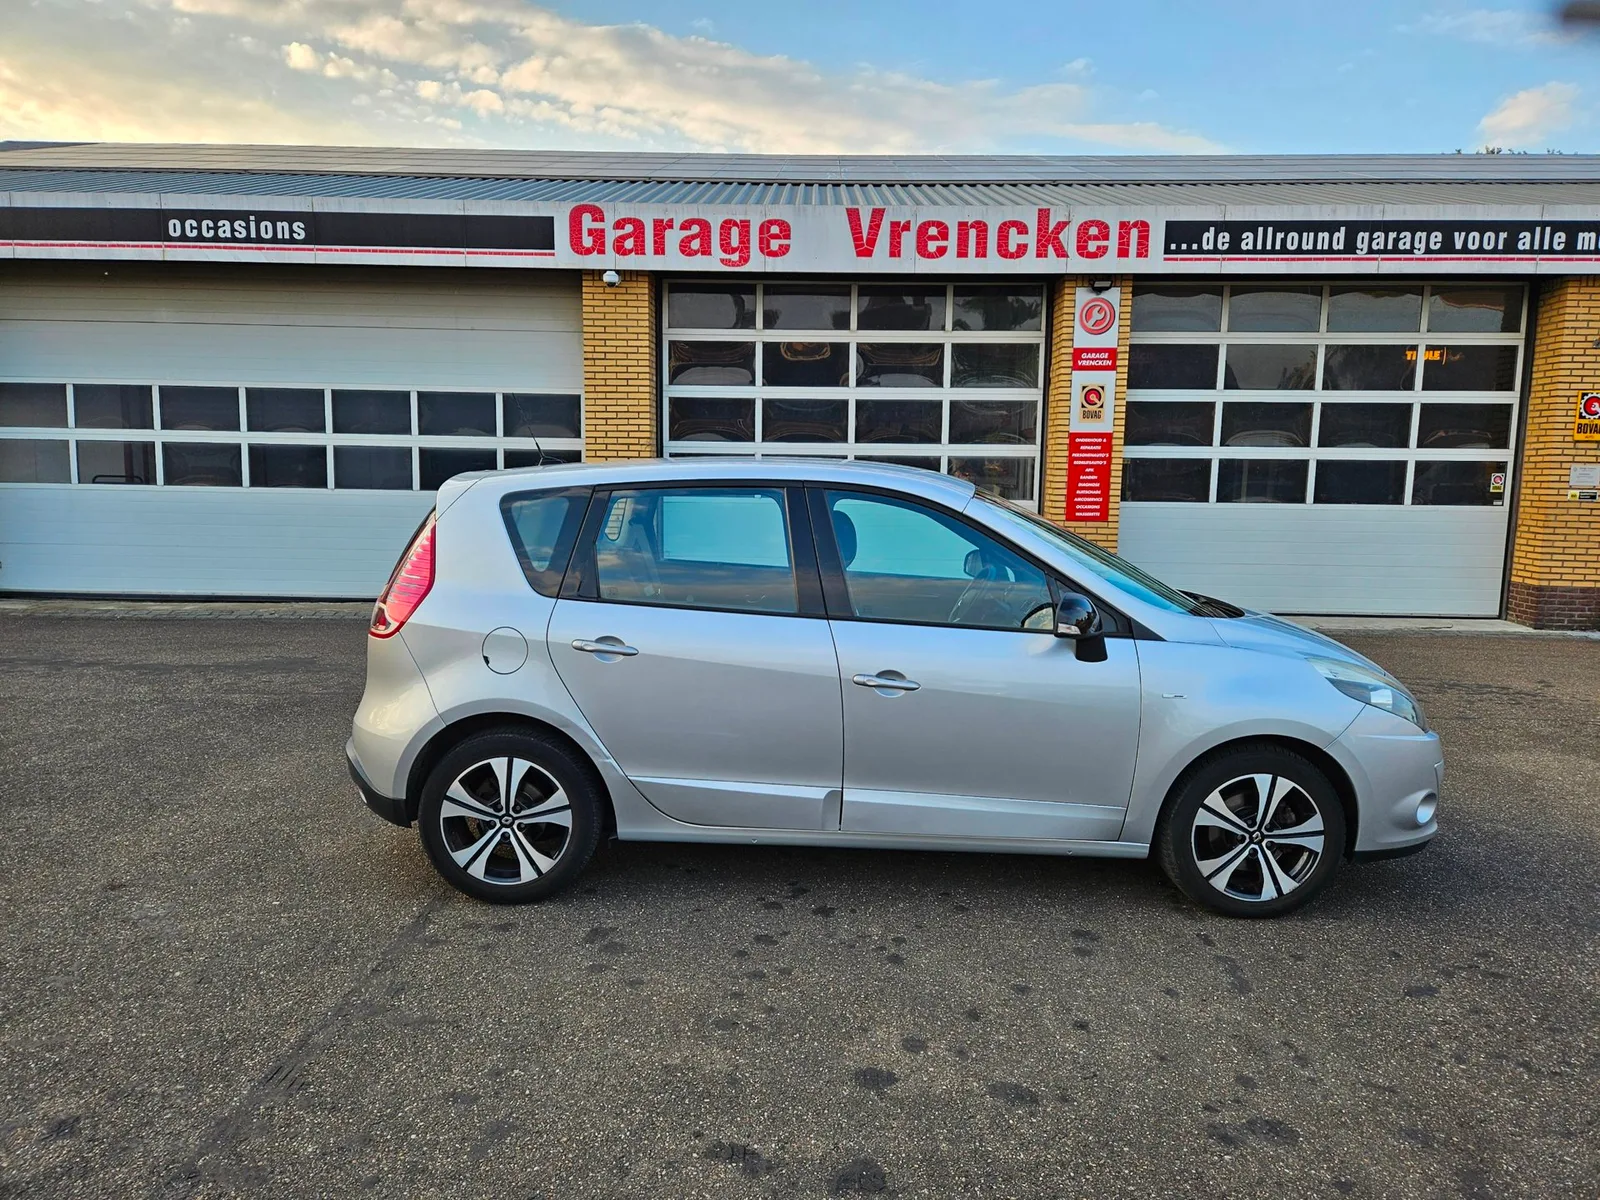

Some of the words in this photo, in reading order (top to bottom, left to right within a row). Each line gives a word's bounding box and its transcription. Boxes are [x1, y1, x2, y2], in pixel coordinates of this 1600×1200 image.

[168, 215, 306, 240] occasions
[568, 203, 792, 268] Garage
[845, 207, 1151, 260] Vrencken
[1170, 226, 1231, 250] ...de
[1240, 226, 1346, 250] allround
[1355, 230, 1443, 255] garage
[1453, 230, 1508, 250] voor
[1517, 226, 1567, 250] alle
[1576, 230, 1600, 250] m
[1082, 410, 1102, 419] BOVAG
[1576, 422, 1600, 434] BOVA
